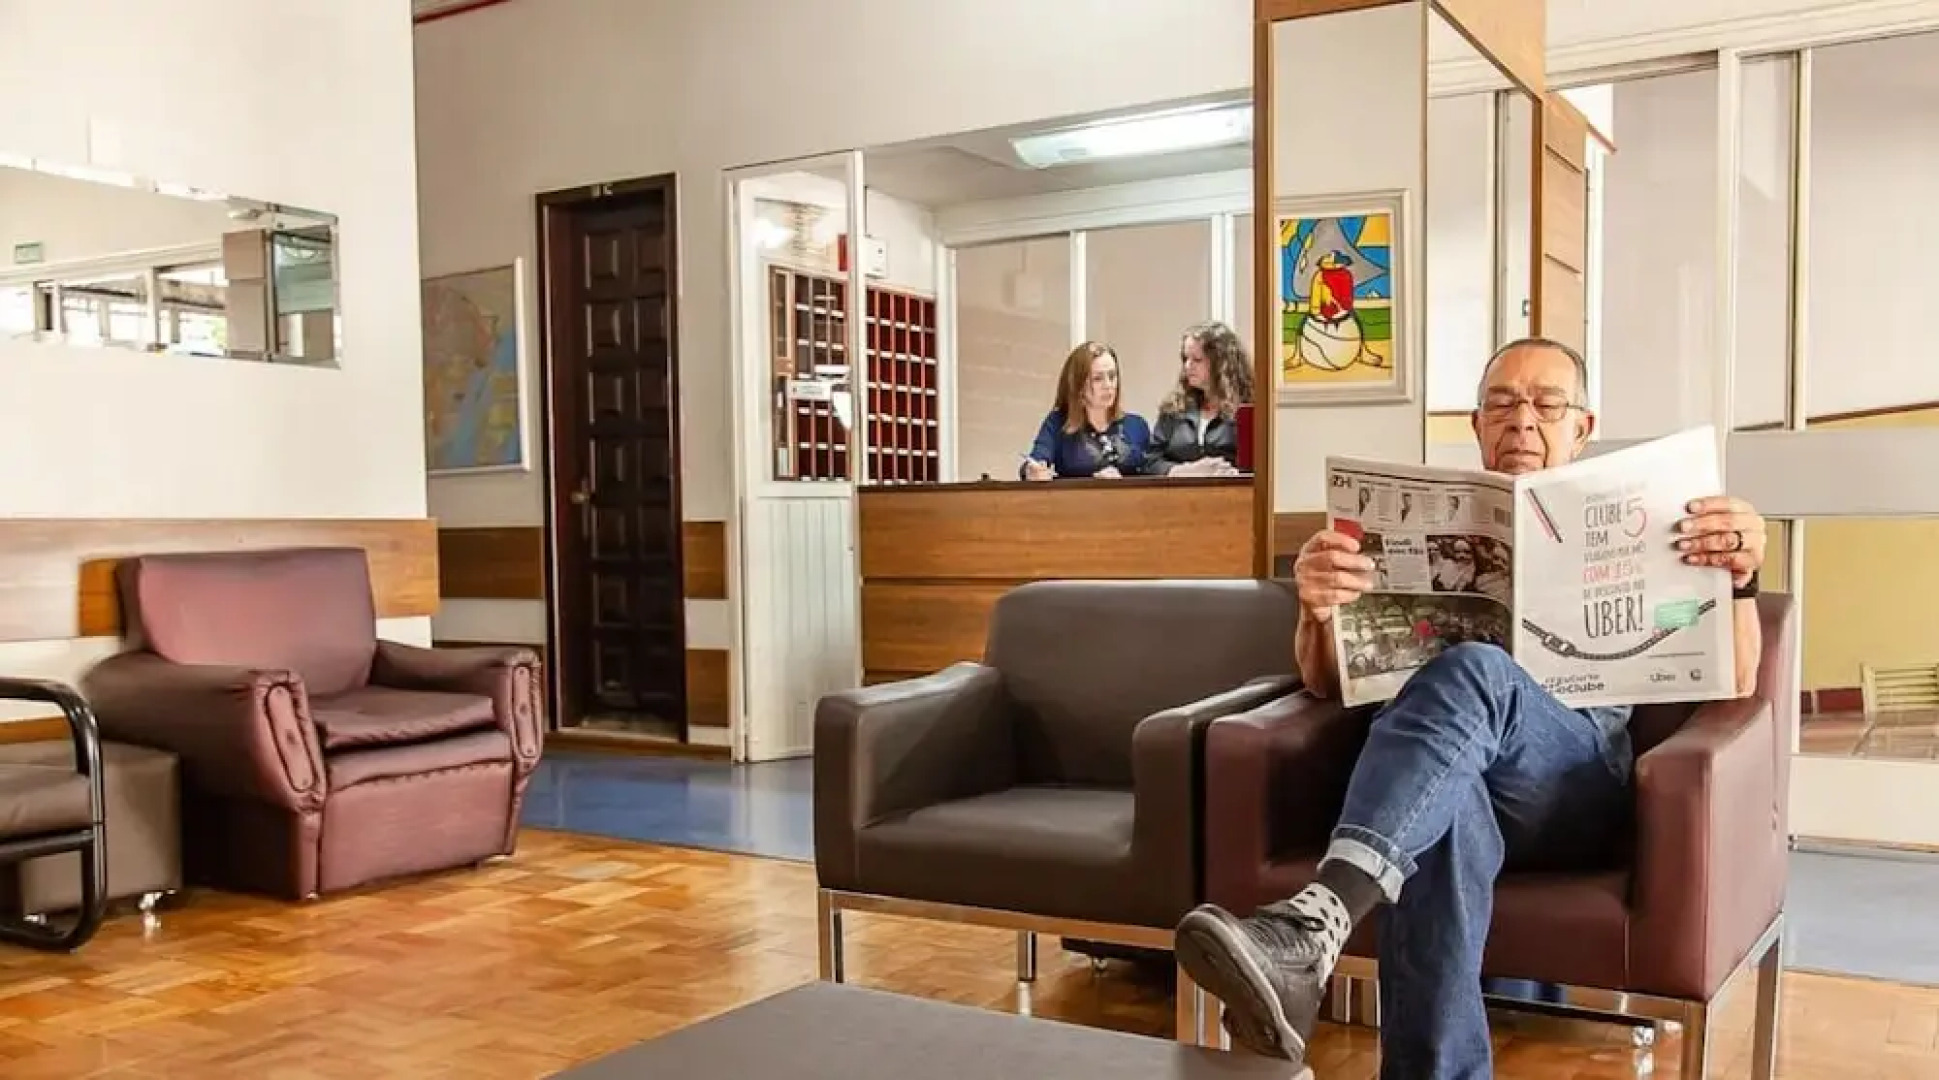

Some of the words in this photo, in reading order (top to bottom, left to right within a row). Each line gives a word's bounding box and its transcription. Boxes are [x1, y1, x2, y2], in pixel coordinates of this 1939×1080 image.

[1584, 503, 1622, 528] CLUBE
[1623, 496, 1647, 538] 5
[1585, 529, 1608, 547] TEM
[1583, 593, 1644, 639] UBER!
